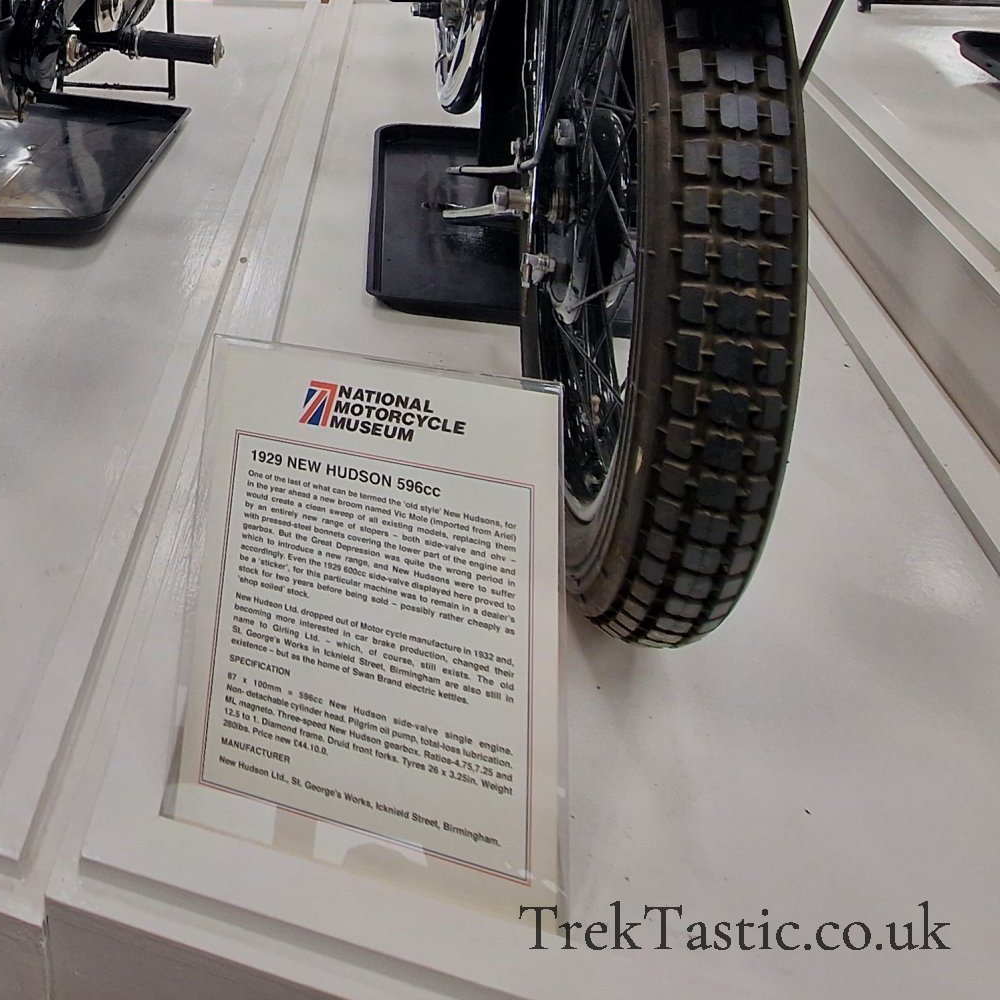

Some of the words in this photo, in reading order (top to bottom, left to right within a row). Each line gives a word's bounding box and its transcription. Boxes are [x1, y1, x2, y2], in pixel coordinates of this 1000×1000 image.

[333, 400, 467, 435] MOTORCYCLE
[338, 385, 434, 414] NATIONAL
[329, 415, 415, 442] MUSEUM
[247, 469, 263, 479] One
[287, 477, 301, 486] last
[312, 483, 330, 493] what
[332, 487, 346, 495] can
[359, 492, 387, 504] termed
[443, 508, 461, 518] New
[251, 449, 282, 466] 1929
[287, 455, 321, 473] NEW
[326, 463, 391, 488] HUDSON
[396, 477, 441, 497] 596cc
[245, 491, 268, 501] would
[271, 496, 294, 506] create
[305, 503, 326, 513] clean
[329, 508, 354, 520] sweep
[381, 519, 413, 533] existing
[452, 534, 491, 549] replacing
[495, 542, 516, 552] them
[269, 485, 287, 494] year
[287, 489, 311, 499] ahead
[319, 495, 335, 504] new
[337, 498, 363, 510] broom
[364, 505, 391, 516] named
[408, 512, 428, 523] Mole
[472, 525, 491, 536] from
[241, 532, 264, 543] which
[277, 539, 314, 554] introduce
[325, 551, 342, 560] new
[373, 562, 389, 571] and
[392, 564, 410, 575] New
[413, 569, 450, 585] Hudsons
[453, 580, 474, 590] were
[490, 588, 516, 599] suffer
[243, 511, 260, 520] with
[261, 515, 312, 531] pressed-steel
[313, 525, 345, 539] bonnets
[346, 534, 381, 548] covering
[383, 540, 397, 550] the
[398, 543, 421, 555] lower
[423, 550, 440, 560] part
[453, 555, 467, 565] the
[468, 560, 498, 572] engine
[499, 567, 516, 576] and
[278, 528, 292, 538] But
[310, 536, 332, 547] Great
[335, 541, 380, 557] Depression
[384, 553, 400, 562] was
[403, 557, 425, 567] quite
[428, 561, 442, 571] the
[445, 566, 472, 580] wrong
[475, 573, 503, 585] period
[287, 552, 307, 564] Even
[323, 561, 341, 572] 1929
[343, 565, 366, 577] 600cc
[368, 572, 410, 587] side-valve
[410, 581, 451, 597] displayed
[453, 590, 472, 601] here
[474, 596, 504, 609] proved
[229, 653, 290, 677] SPECIFICATION
[234, 602, 272, 620] becoming
[275, 614, 296, 624] more
[299, 618, 339, 635] interested
[354, 633, 368, 642] car
[372, 636, 396, 649] brake
[452, 657, 490, 673] changed
[494, 666, 515, 678] their
[245, 628, 280, 644] George's
[283, 638, 309, 651] Works
[389, 664, 441, 685] Birmingham
[444, 680, 459, 690] are
[462, 684, 482, 695] also
[485, 690, 501, 700] still
[221, 736, 290, 764] MANUFACTURER
[218, 754, 236, 767] New
[238, 760, 269, 777] Hudson
[304, 780, 342, 799] George's
